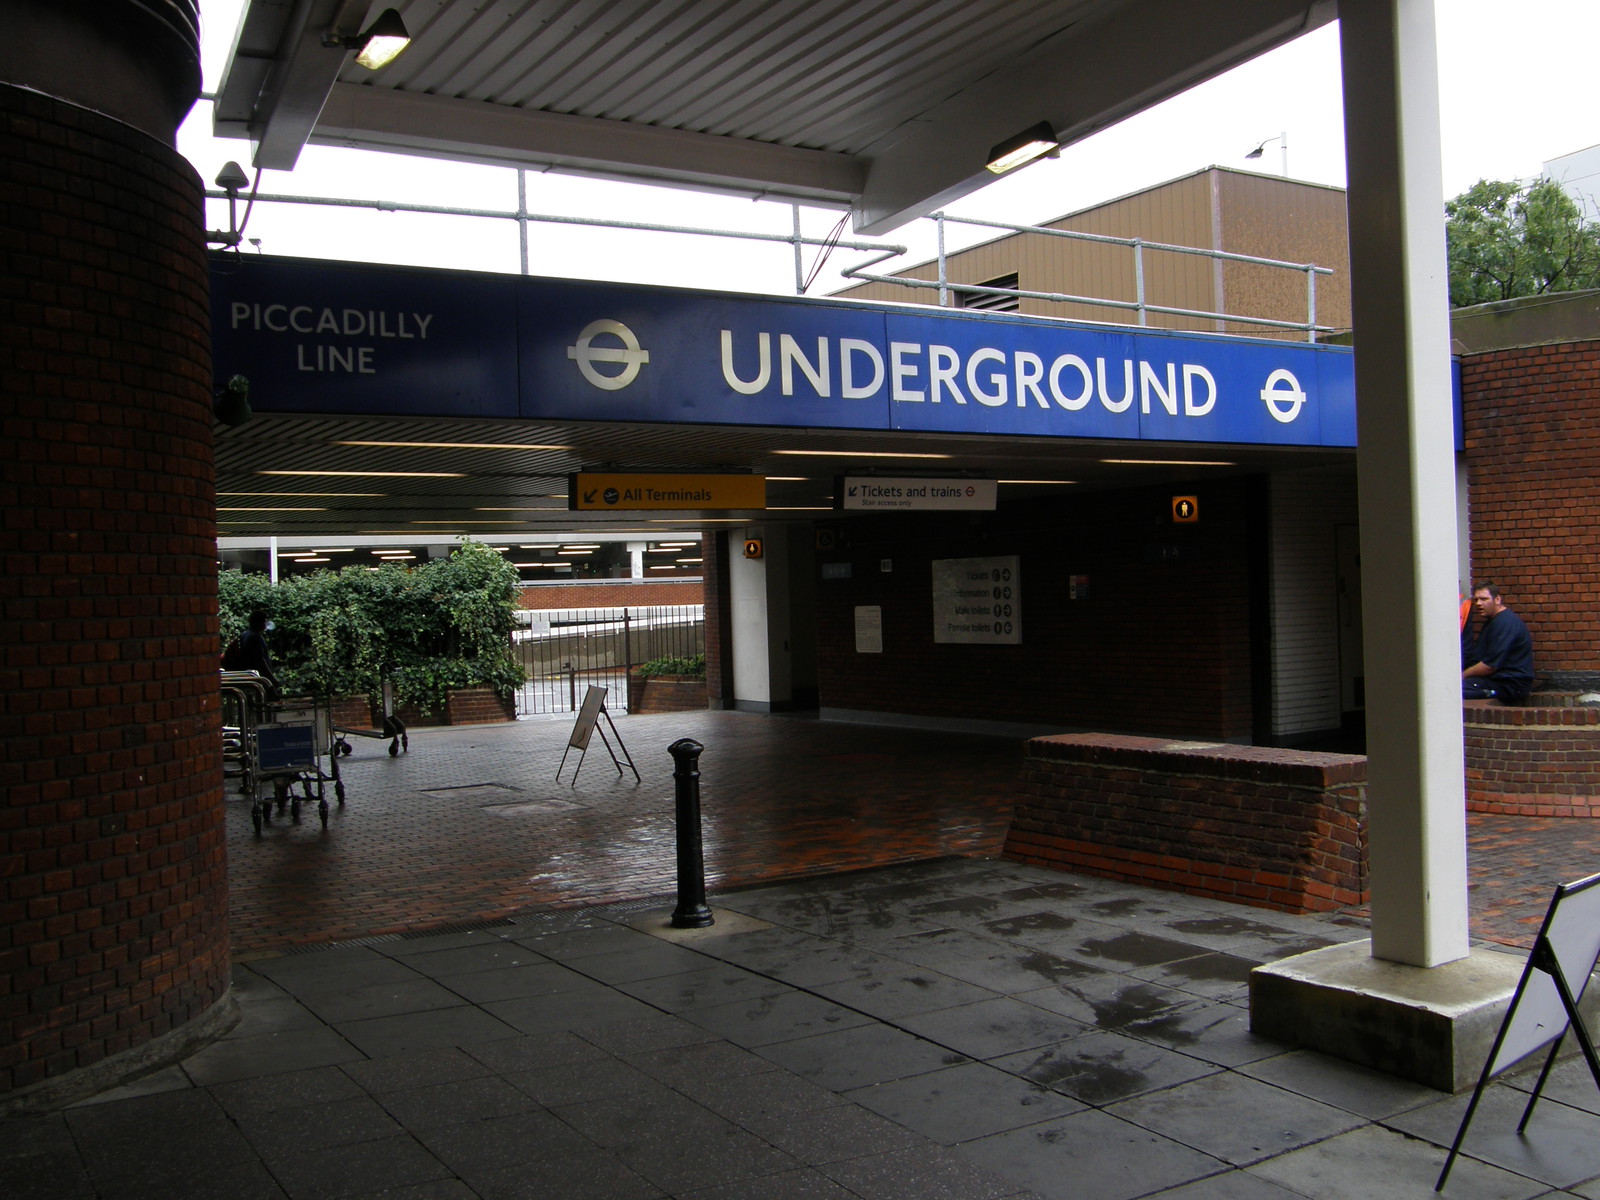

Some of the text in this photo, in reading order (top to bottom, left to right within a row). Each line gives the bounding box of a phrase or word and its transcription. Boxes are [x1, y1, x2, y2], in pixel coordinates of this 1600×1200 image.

[231, 302, 433, 339] PICCADILLY
[297, 344, 376, 374] LINE
[720, 329, 1217, 417] UNDERGROUND
[623, 488, 712, 501] All Terminals
[861, 485, 961, 497] Tickets and trains
[966, 571, 989, 580] Tickets
[955, 606, 990, 615] Male toilets
[971, 623, 991, 632] toilets
